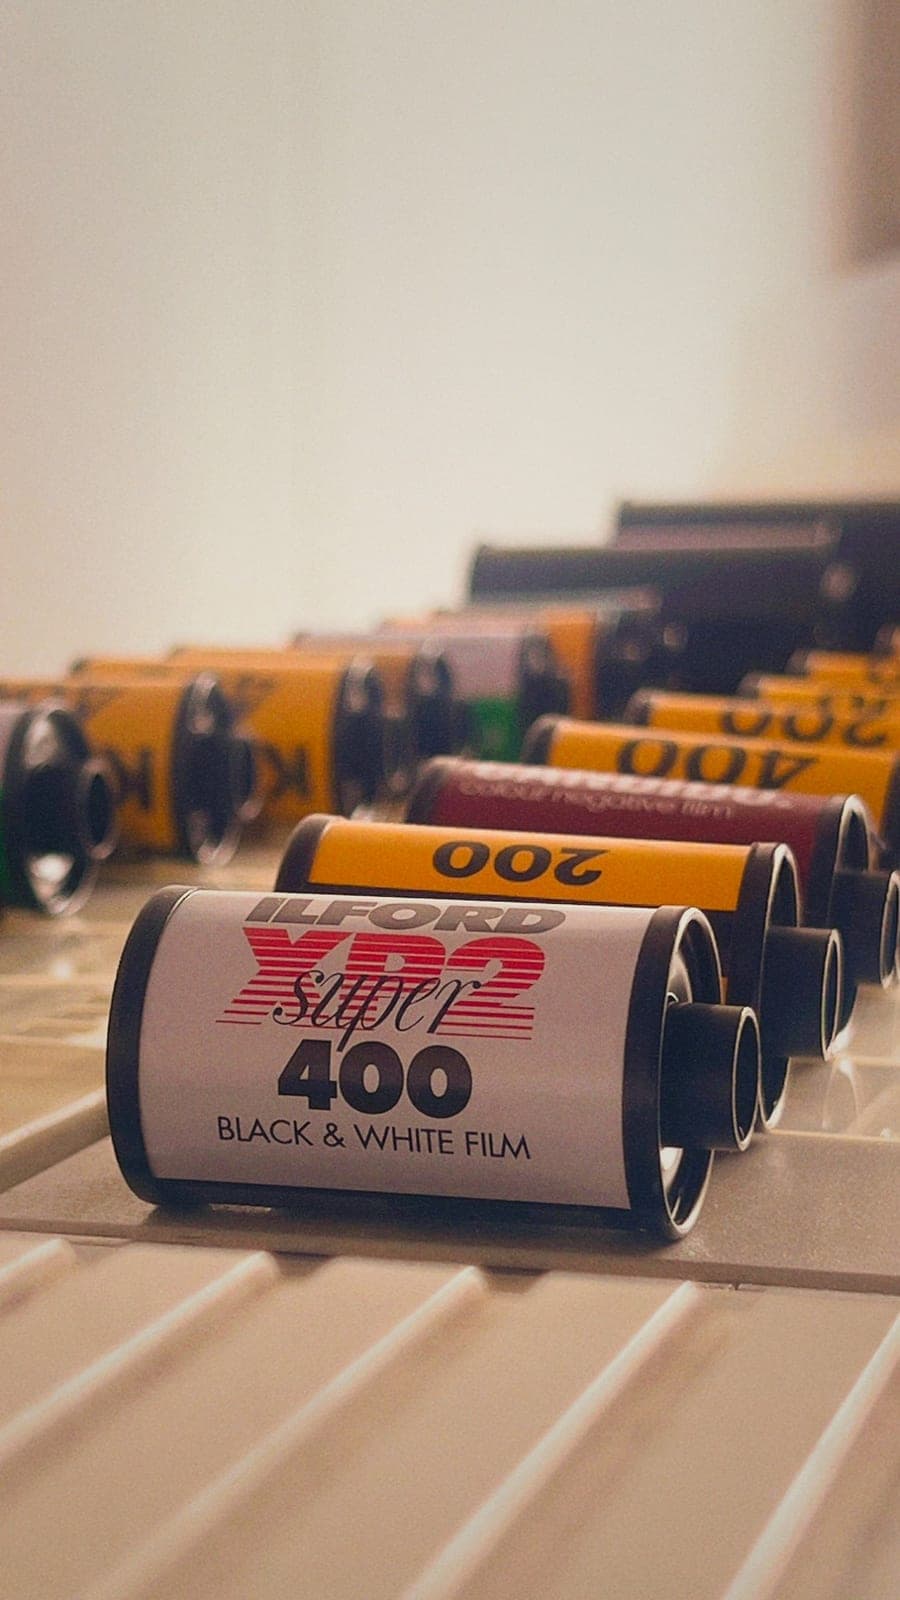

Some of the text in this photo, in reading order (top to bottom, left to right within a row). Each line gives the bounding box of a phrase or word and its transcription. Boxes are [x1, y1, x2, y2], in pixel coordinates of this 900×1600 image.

[616, 739, 820, 790] 400
[432, 841, 610, 886] 200
[245, 897, 566, 934] ILFORD
[215, 927, 546, 1040] XP2
[272, 969, 482, 1052] super
[278, 1039, 472, 1118] 400
[218, 1116, 531, 1160] BLACK & WHITE FILM
